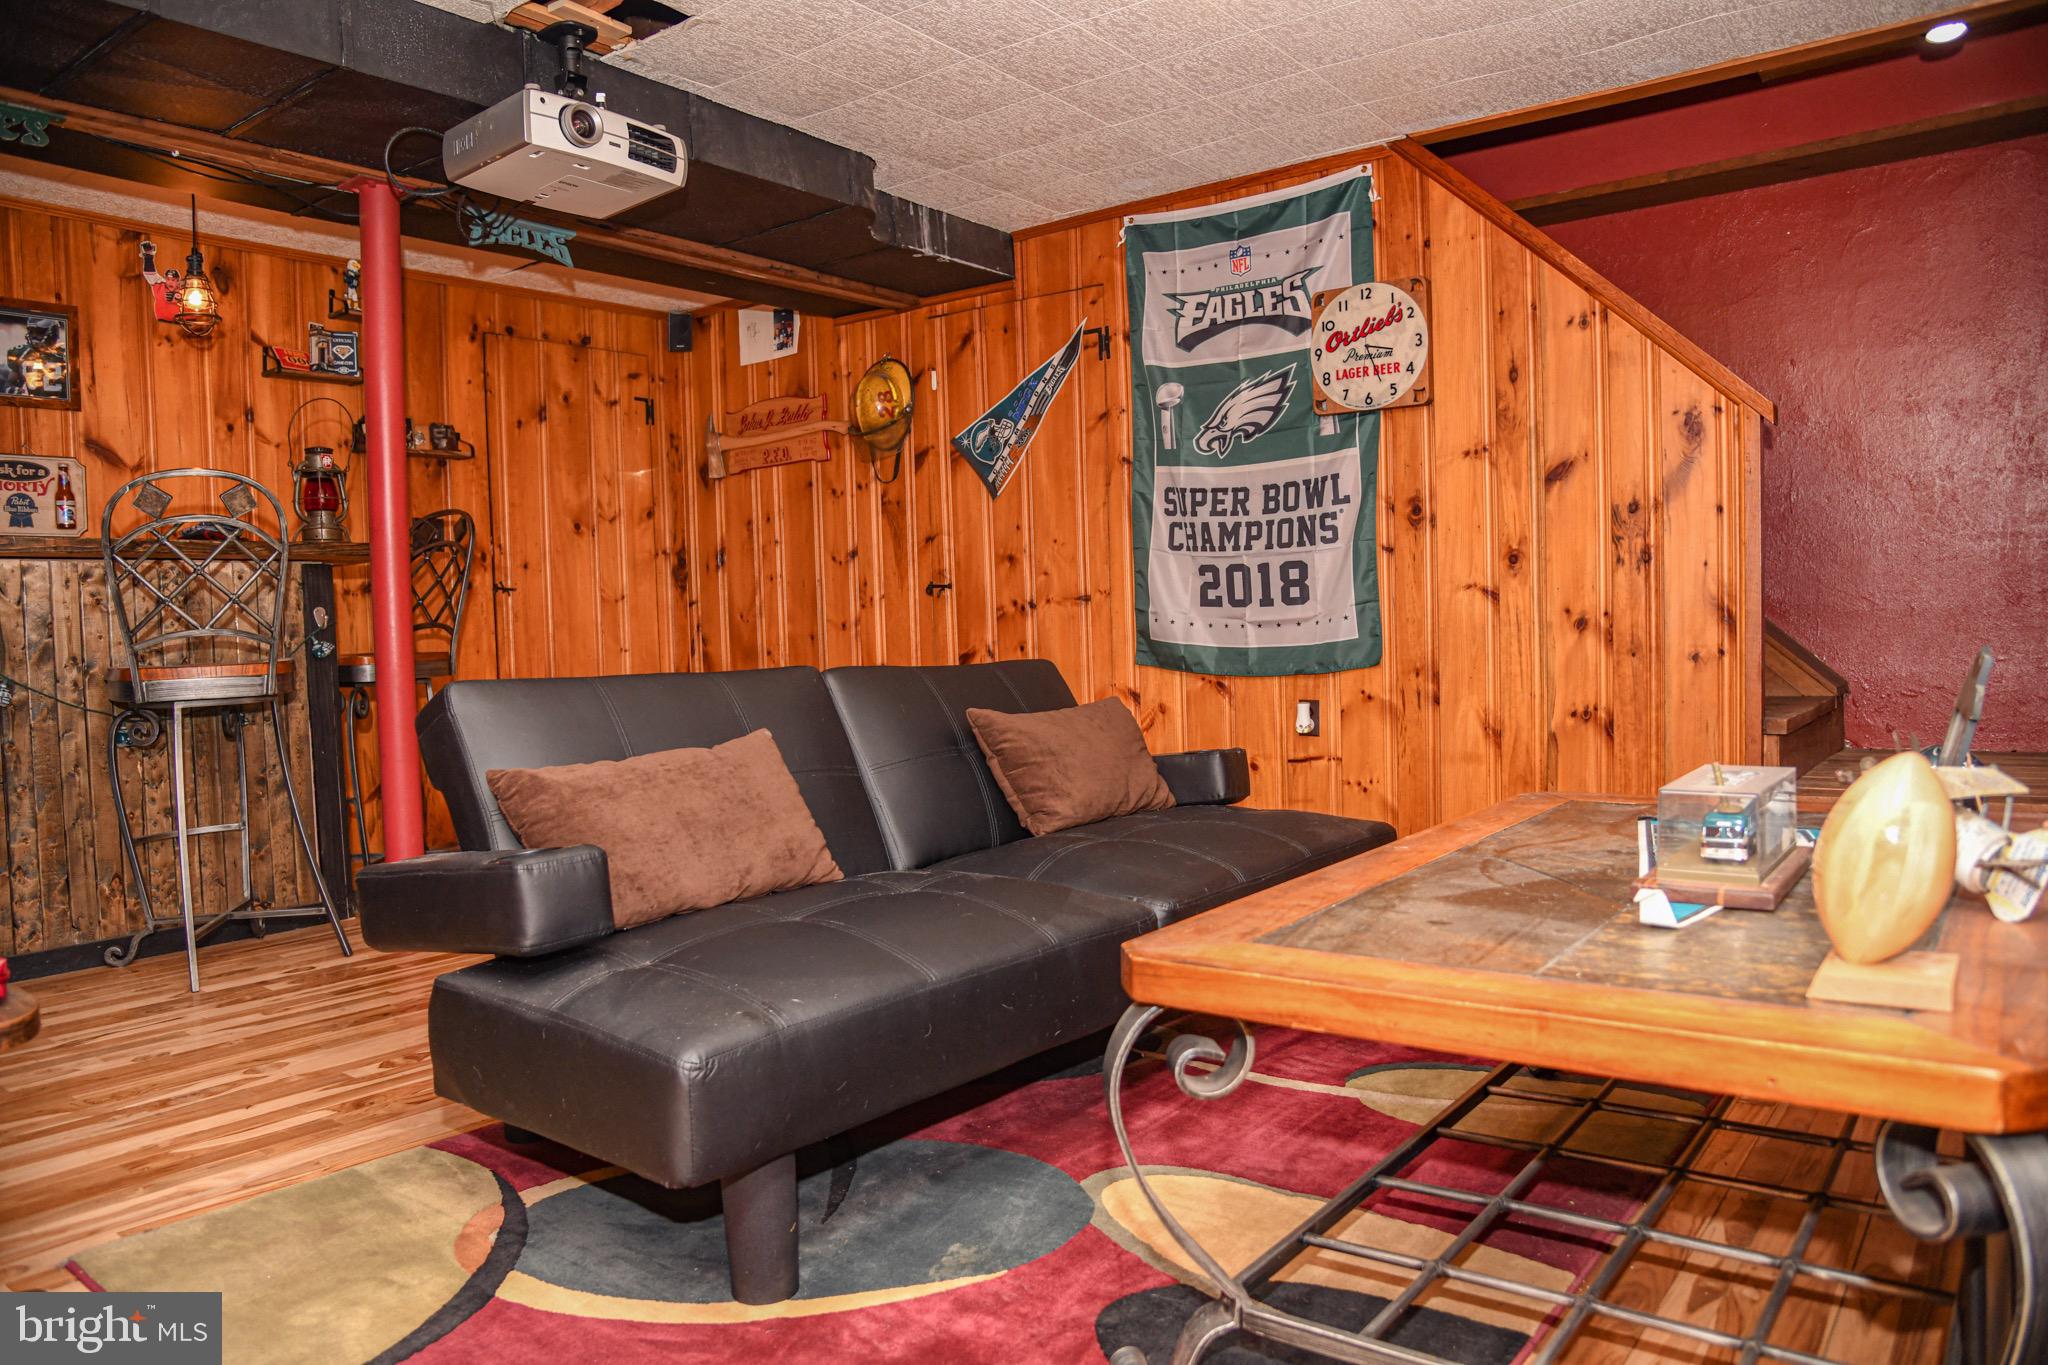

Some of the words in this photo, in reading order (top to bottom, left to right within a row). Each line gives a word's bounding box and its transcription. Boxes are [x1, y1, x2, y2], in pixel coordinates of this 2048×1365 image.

[1231, 257, 1250, 275] NFL
[1215, 277, 1277, 293] PHILADELPHIA
[1360, 287, 1372, 300] 12
[1166, 270, 1312, 346] EAGLES
[1338, 300, 1348, 312] 11
[1407, 306, 1415, 319] 2
[1322, 320, 1335, 332] 10
[1325, 301, 1404, 353] Ortlieb's
[1415, 333, 1423, 347] 3
[1314, 348, 1323, 361] 9
[1343, 348, 1394, 363] Premium
[1335, 366, 1369, 381] LAGER
[1373, 361, 1401, 376] BEER
[1406, 361, 1415, 374] 4
[1322, 372, 1331, 386] 8
[1343, 389, 1349, 401] 7
[1390, 383, 1398, 396] 5
[1364, 392, 1374, 405] 6
[17, 464, 36, 476] for
[1164, 486, 1250, 517] SUPER
[1262, 473, 1351, 515] BOWL
[1168, 511, 1339, 552] CHAMPIONS
[1198, 560, 1311, 608] 2018
